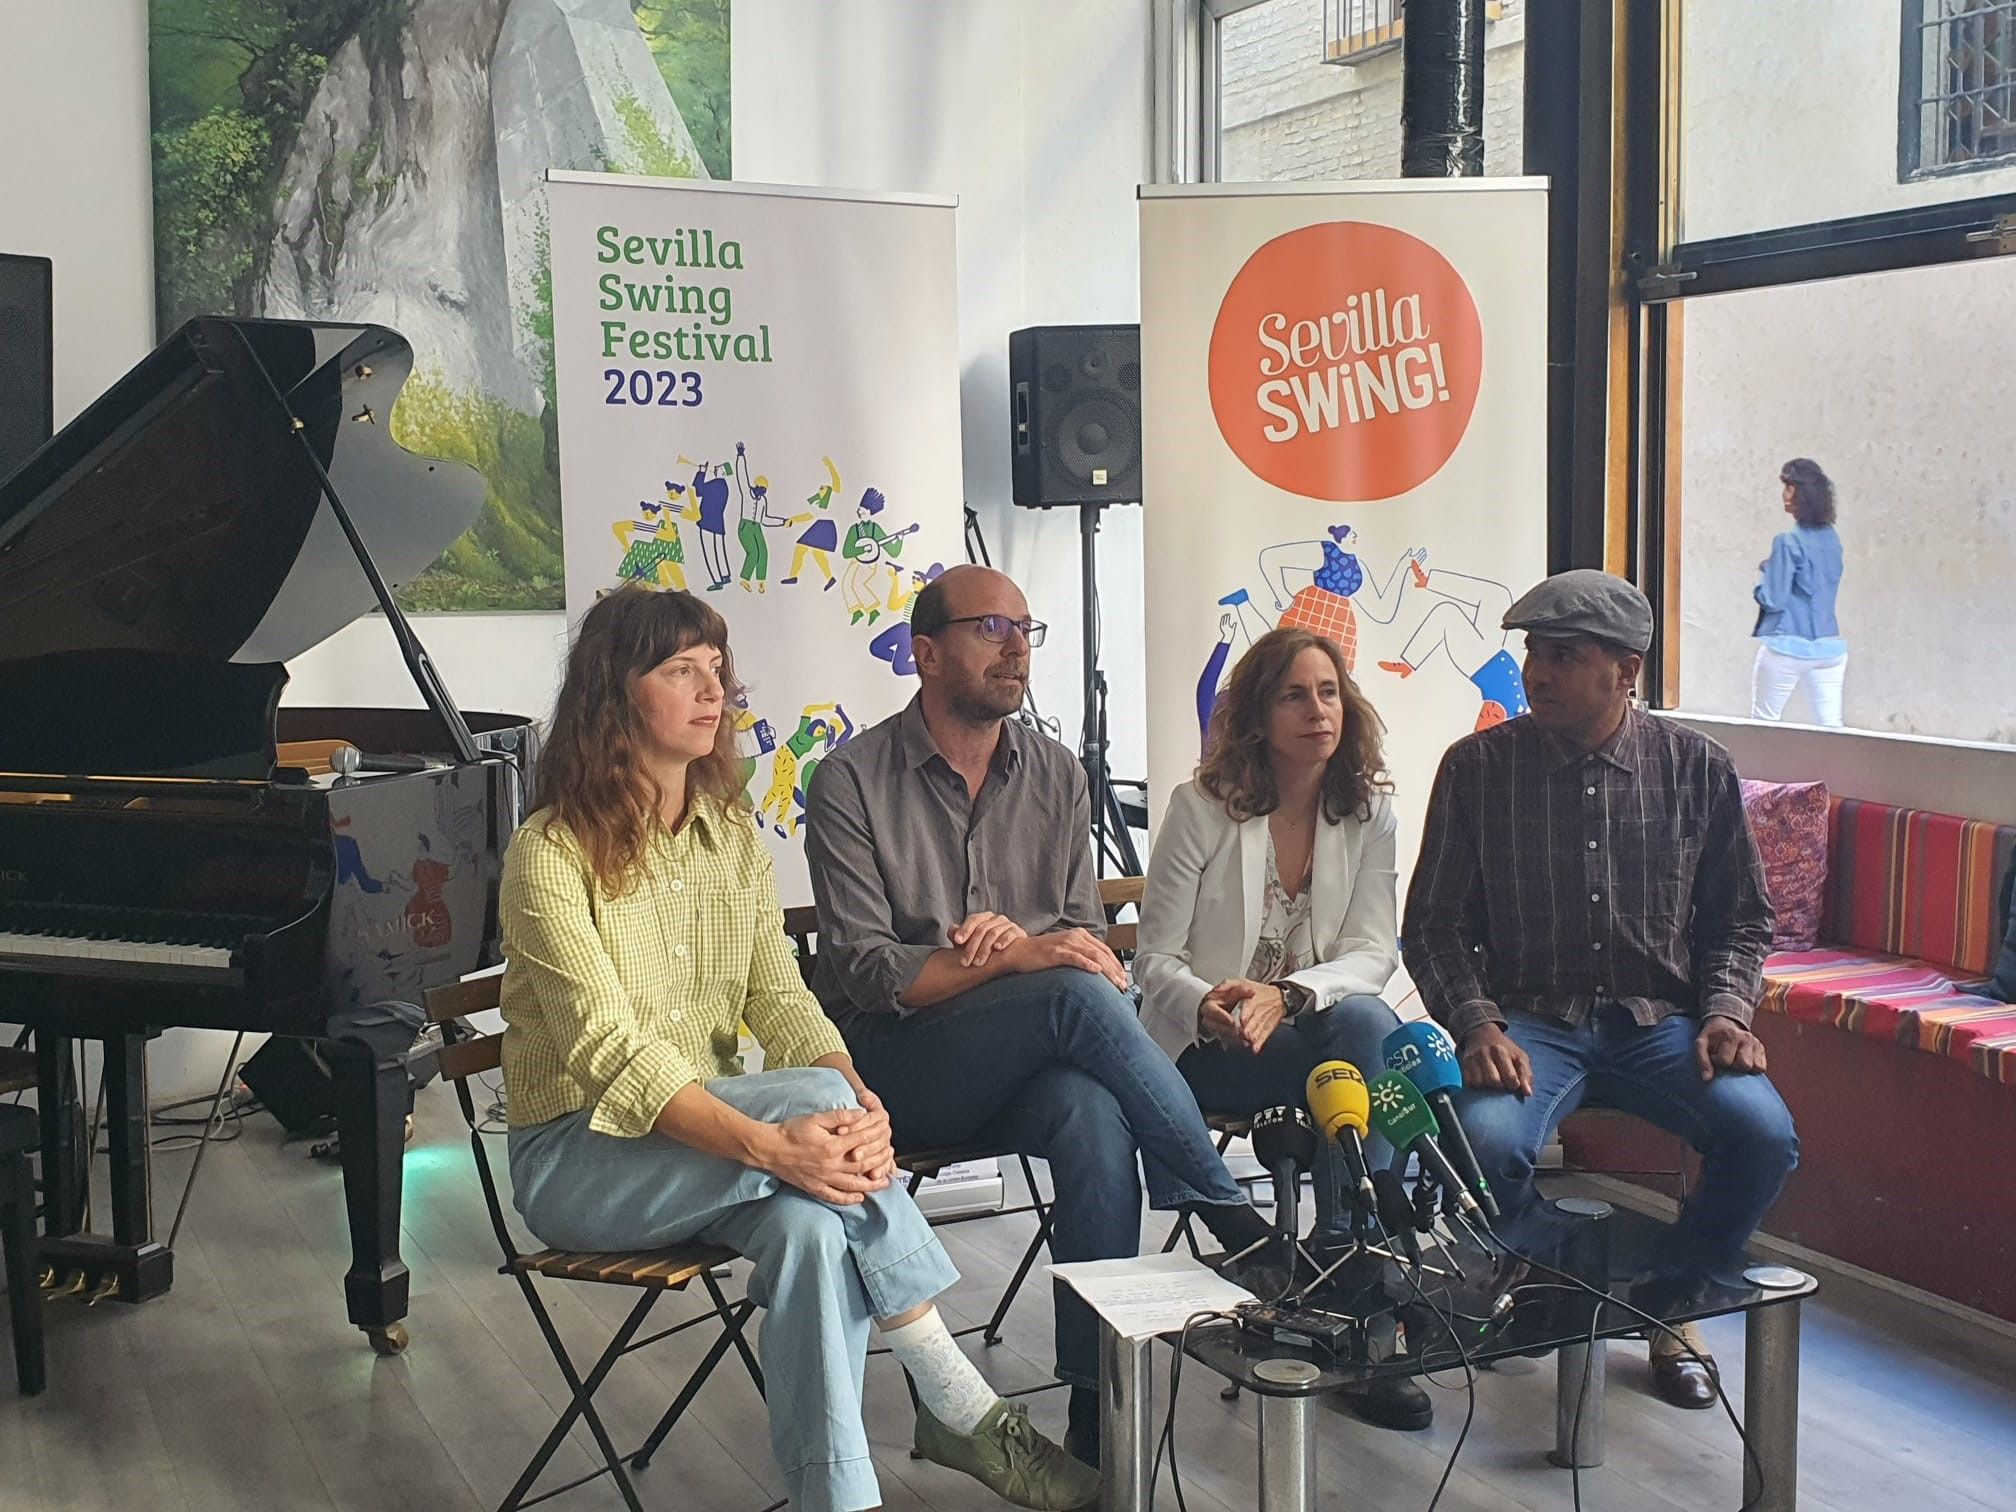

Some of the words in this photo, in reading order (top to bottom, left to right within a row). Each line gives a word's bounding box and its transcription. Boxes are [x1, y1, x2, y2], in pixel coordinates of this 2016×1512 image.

[597, 226, 744, 270] Sevilla
[599, 274, 732, 326] Swing
[601, 321, 773, 362] Festival
[1258, 288, 1430, 376] Sevilla
[604, 369, 704, 407] 2023
